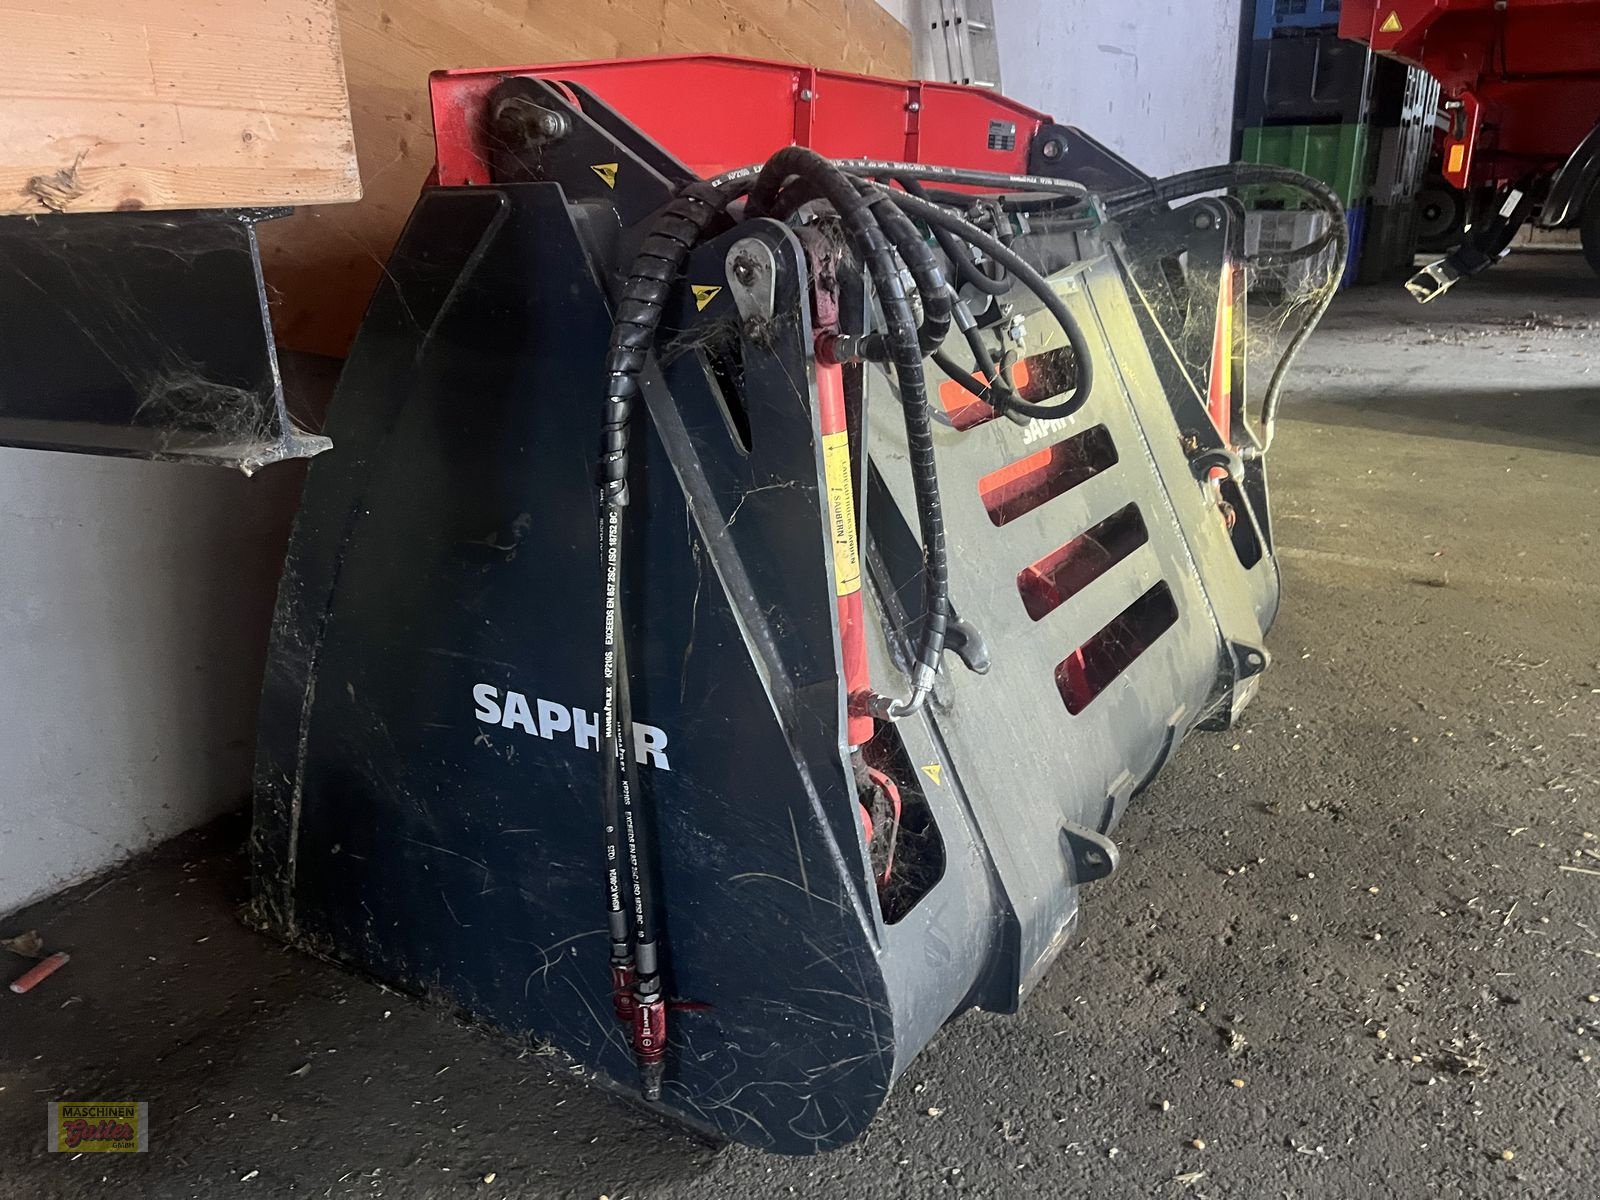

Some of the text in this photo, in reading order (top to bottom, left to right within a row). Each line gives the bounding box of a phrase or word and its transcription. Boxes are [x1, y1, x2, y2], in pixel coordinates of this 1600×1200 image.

[609, 511, 618, 524] BC
[609, 525, 618, 546] 18752
[608, 547, 617, 562] ISO
[607, 567, 616, 582] 2SC
[607, 583, 615, 597] 857
[606, 597, 615, 609] EN
[605, 611, 614, 645] EXCEEDS
[604, 651, 613, 678] KP210S
[472, 683, 671, 771] SAPHR
[625, 811, 635, 843] EXCEEDS
[628, 843, 637, 853] EN
[633, 883, 641, 895] ISO
[612, 892, 620, 911] MSHA
